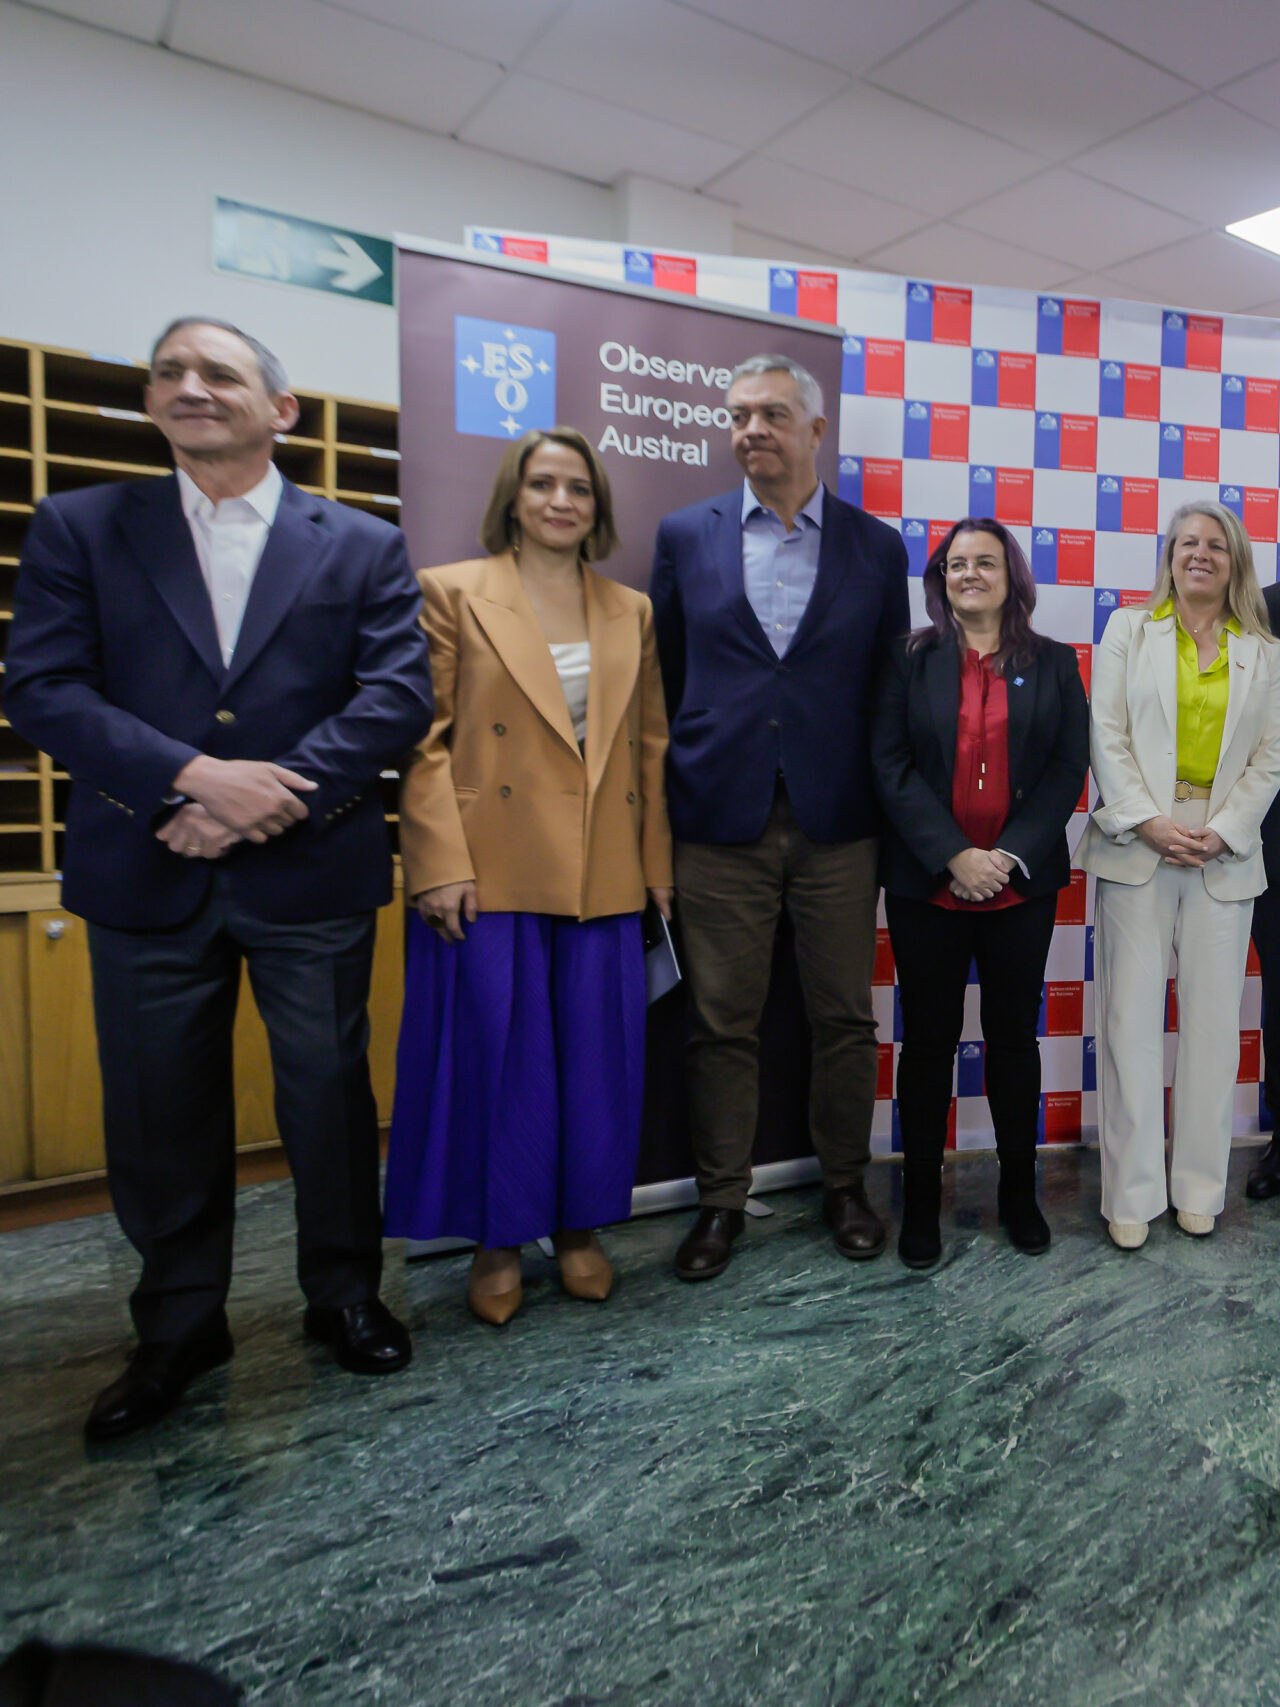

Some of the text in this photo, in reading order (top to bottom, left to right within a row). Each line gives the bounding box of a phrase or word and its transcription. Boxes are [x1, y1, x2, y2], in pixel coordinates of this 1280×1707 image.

[600, 341, 734, 389] Observa
[600, 382, 733, 430] Europeo
[598, 424, 708, 467] Austral
